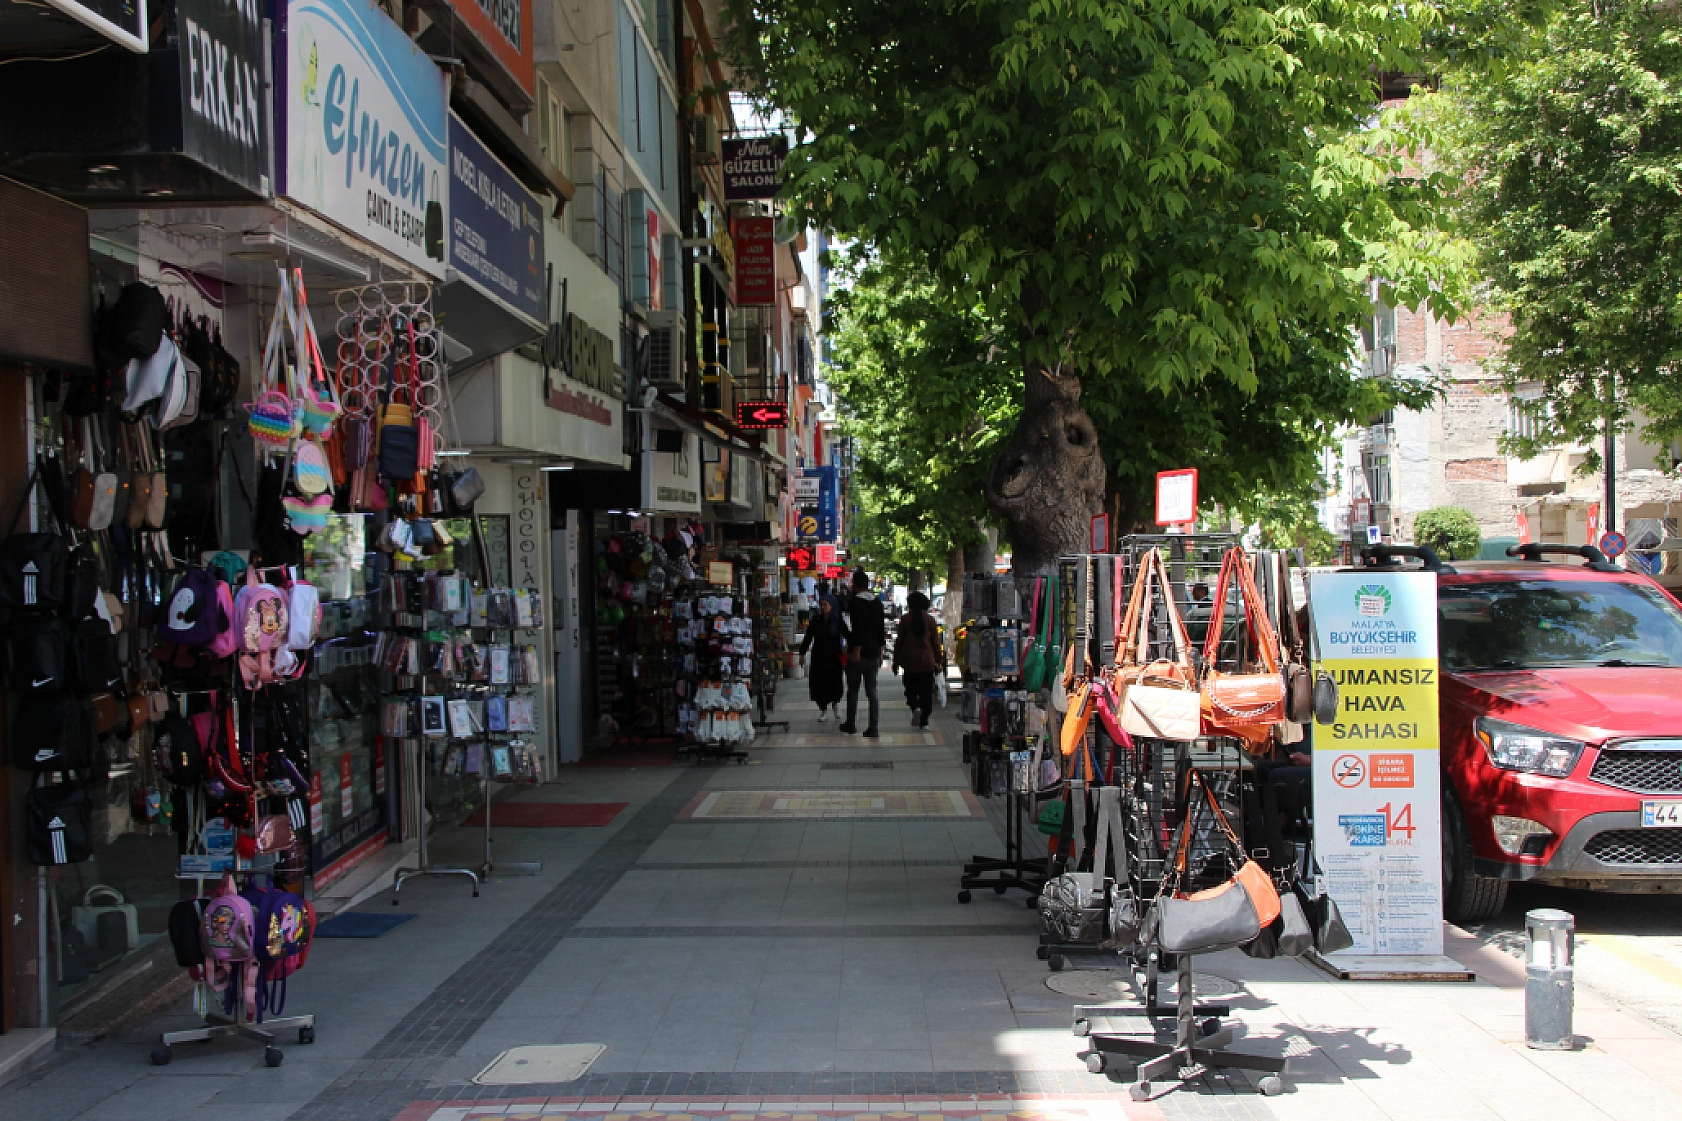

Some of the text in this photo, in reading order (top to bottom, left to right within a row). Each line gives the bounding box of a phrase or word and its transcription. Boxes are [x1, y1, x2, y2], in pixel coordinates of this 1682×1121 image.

[186, 18, 259, 148] ERKAN
[324, 63, 426, 211] Efruzen
[453, 146, 478, 194] NOBEL
[366, 188, 392, 231] ÇANTA
[393, 206, 400, 235] &
[517, 475, 537, 586] CHOCOLA
[1330, 631, 1417, 645] BÜYÜKŞEHİR
[1351, 620, 1396, 629] MALATYA
[1344, 695, 1406, 712] HAVA
[1332, 723, 1418, 739] SAHASI
[1376, 802, 1417, 839] 14
[1656, 805, 1678, 823] 44
